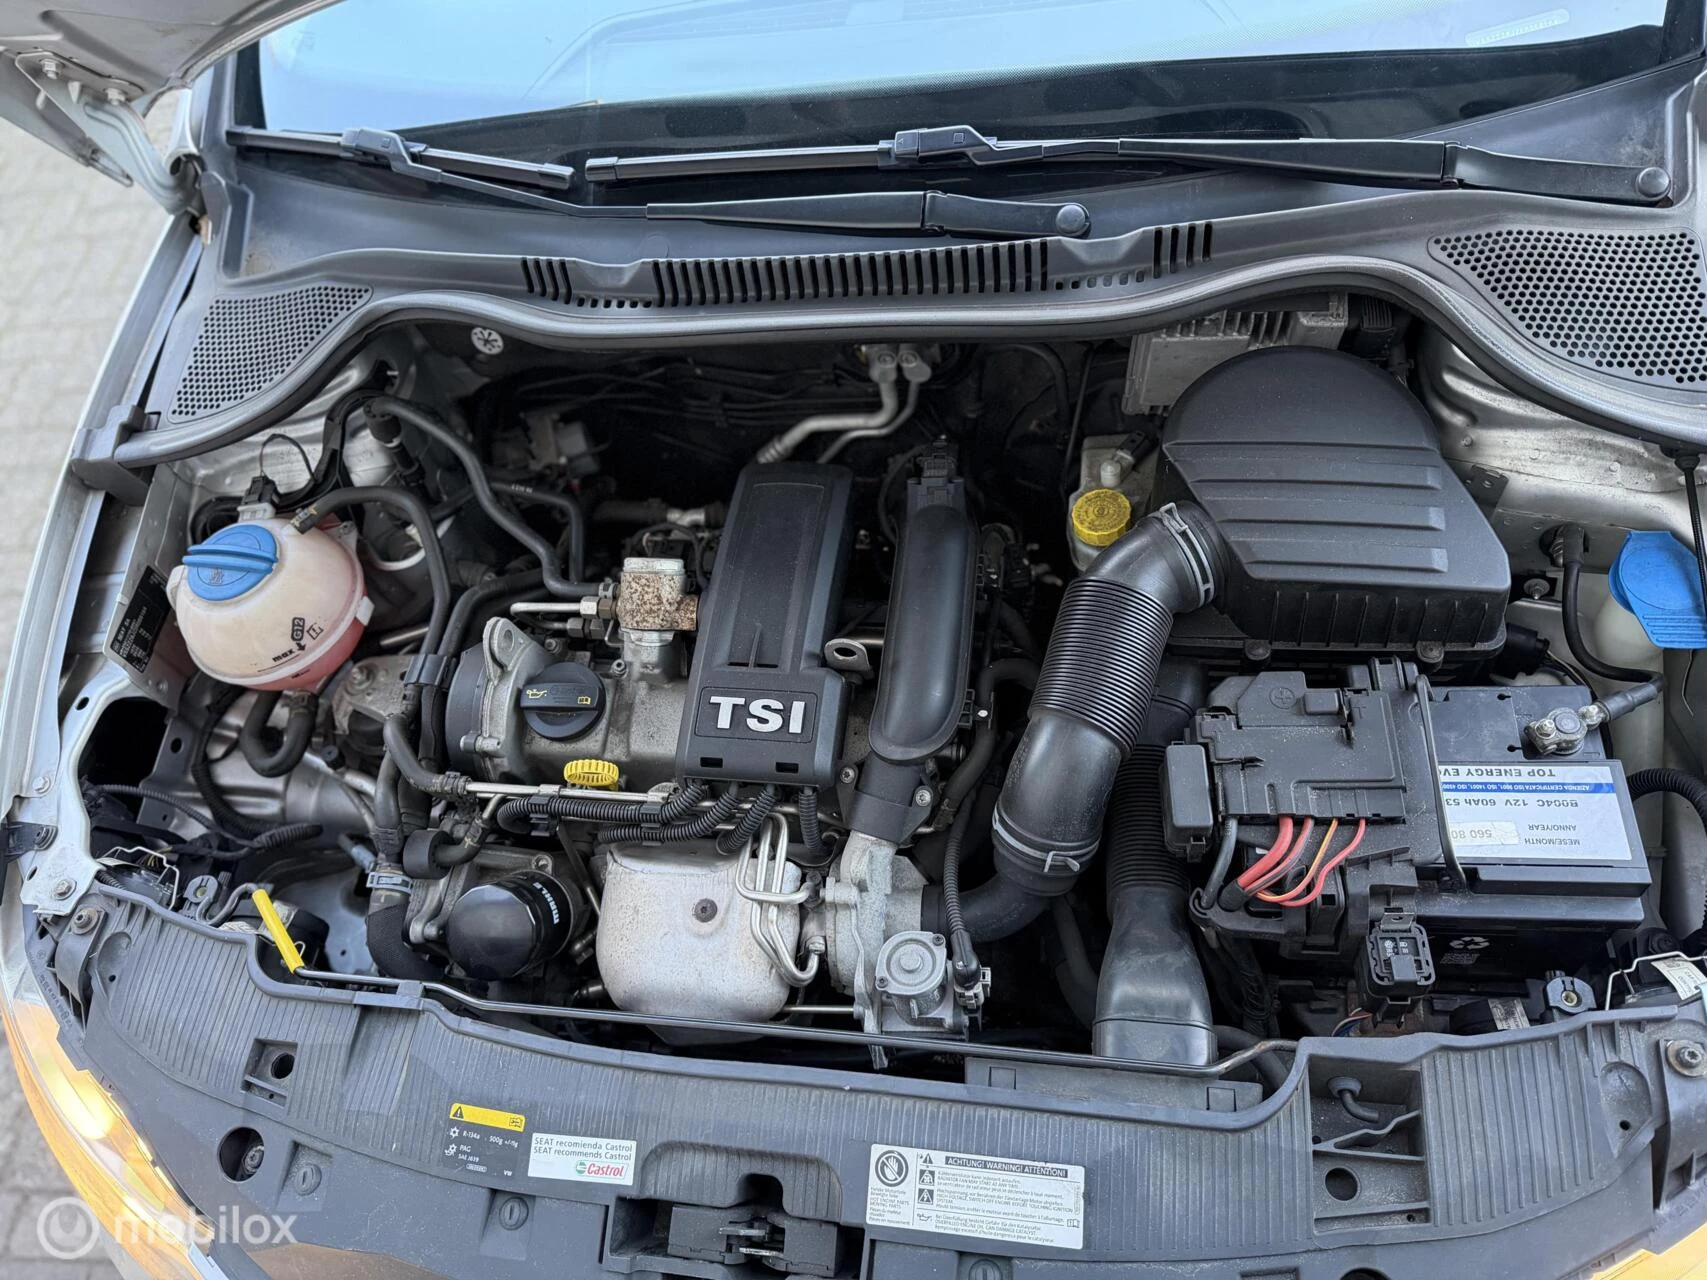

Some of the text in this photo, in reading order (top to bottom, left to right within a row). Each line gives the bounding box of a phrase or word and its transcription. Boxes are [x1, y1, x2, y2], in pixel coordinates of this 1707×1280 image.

[293, 619, 304, 640] G12
[272, 649, 295, 662] max
[709, 696, 805, 734] TSI
[1440, 768, 1556, 777] TOP ENERGY EV
[1465, 798, 1496, 806] 60Ah
[1504, 799, 1528, 807] 12V
[1470, 829, 1492, 838] 560
[533, 882, 560, 924] MAHLE
[534, 1137, 633, 1152] SEAT recomienda Castrol
[533, 1147, 632, 1161] SEAT recommends Castrol
[587, 1163, 625, 1177] Castrol
[947, 1157, 985, 1168] ACHTUNG!
[986, 1161, 1023, 1172] WARNING!
[1024, 1165, 1066, 1177] ATTENTION!
